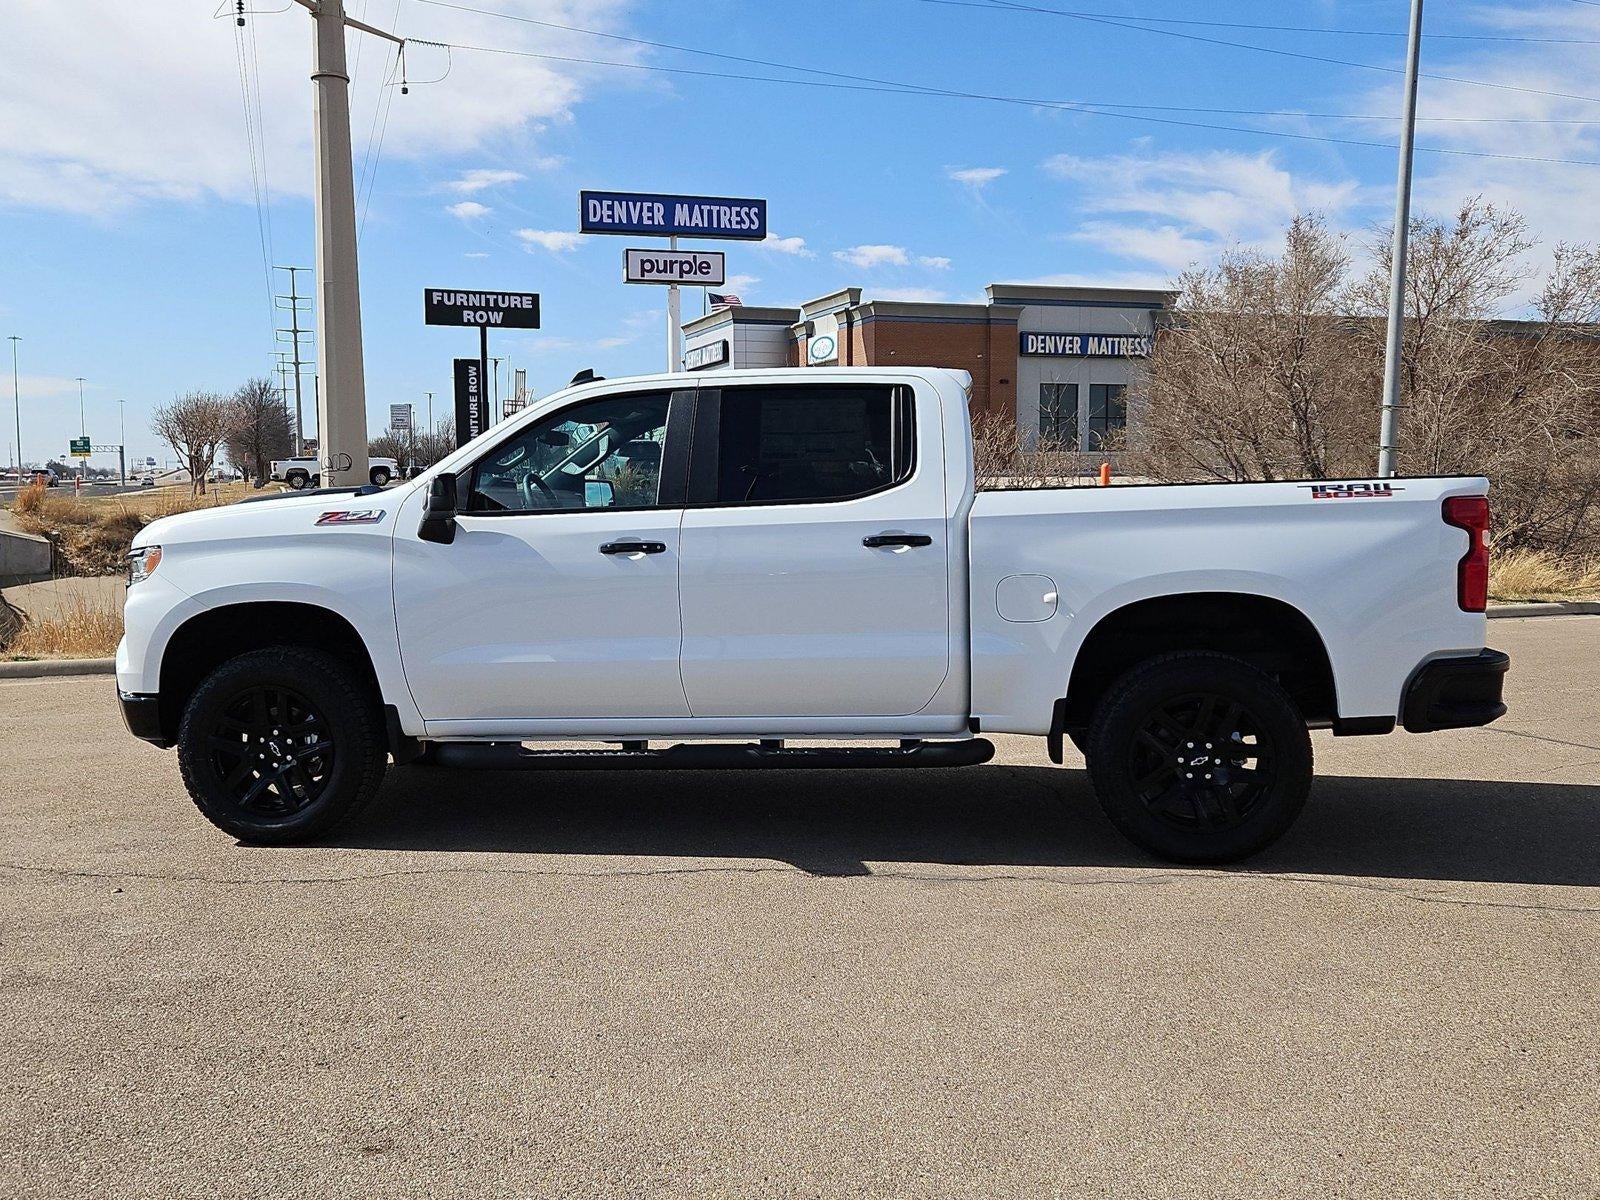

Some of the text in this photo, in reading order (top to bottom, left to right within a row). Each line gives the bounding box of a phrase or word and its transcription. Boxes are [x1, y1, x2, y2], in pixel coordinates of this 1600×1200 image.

[588, 199, 760, 230] DENVER MATTRESS
[640, 255, 712, 279] purple
[432, 291, 533, 309] FURNITURE
[463, 310, 504, 324] ROW
[1027, 335, 1149, 356] DENVER MATTRESS
[468, 365, 479, 442] NITURE ROW
[1312, 490, 1393, 499] BOSS
[314, 509, 387, 526] Z71
